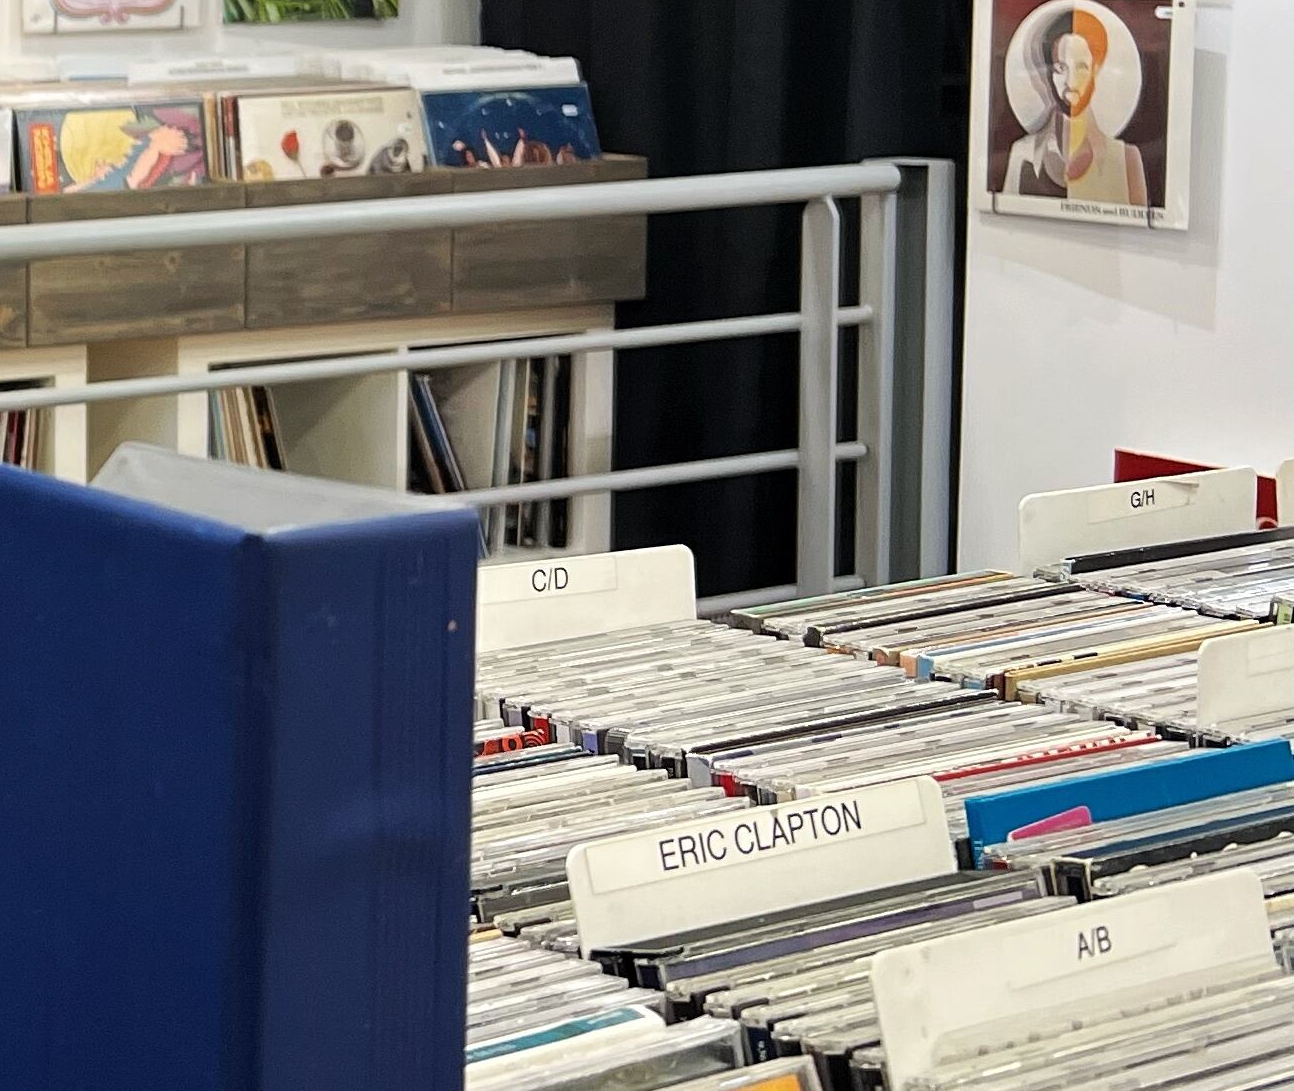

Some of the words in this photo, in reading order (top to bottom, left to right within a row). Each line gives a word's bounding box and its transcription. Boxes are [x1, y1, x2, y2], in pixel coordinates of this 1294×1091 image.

[1131, 488, 1155, 508] G/H
[532, 567, 568, 592] C/D
[659, 829, 727, 871] ERIC
[734, 800, 862, 854] CLAPTON
[1076, 926, 1112, 961] A/B
